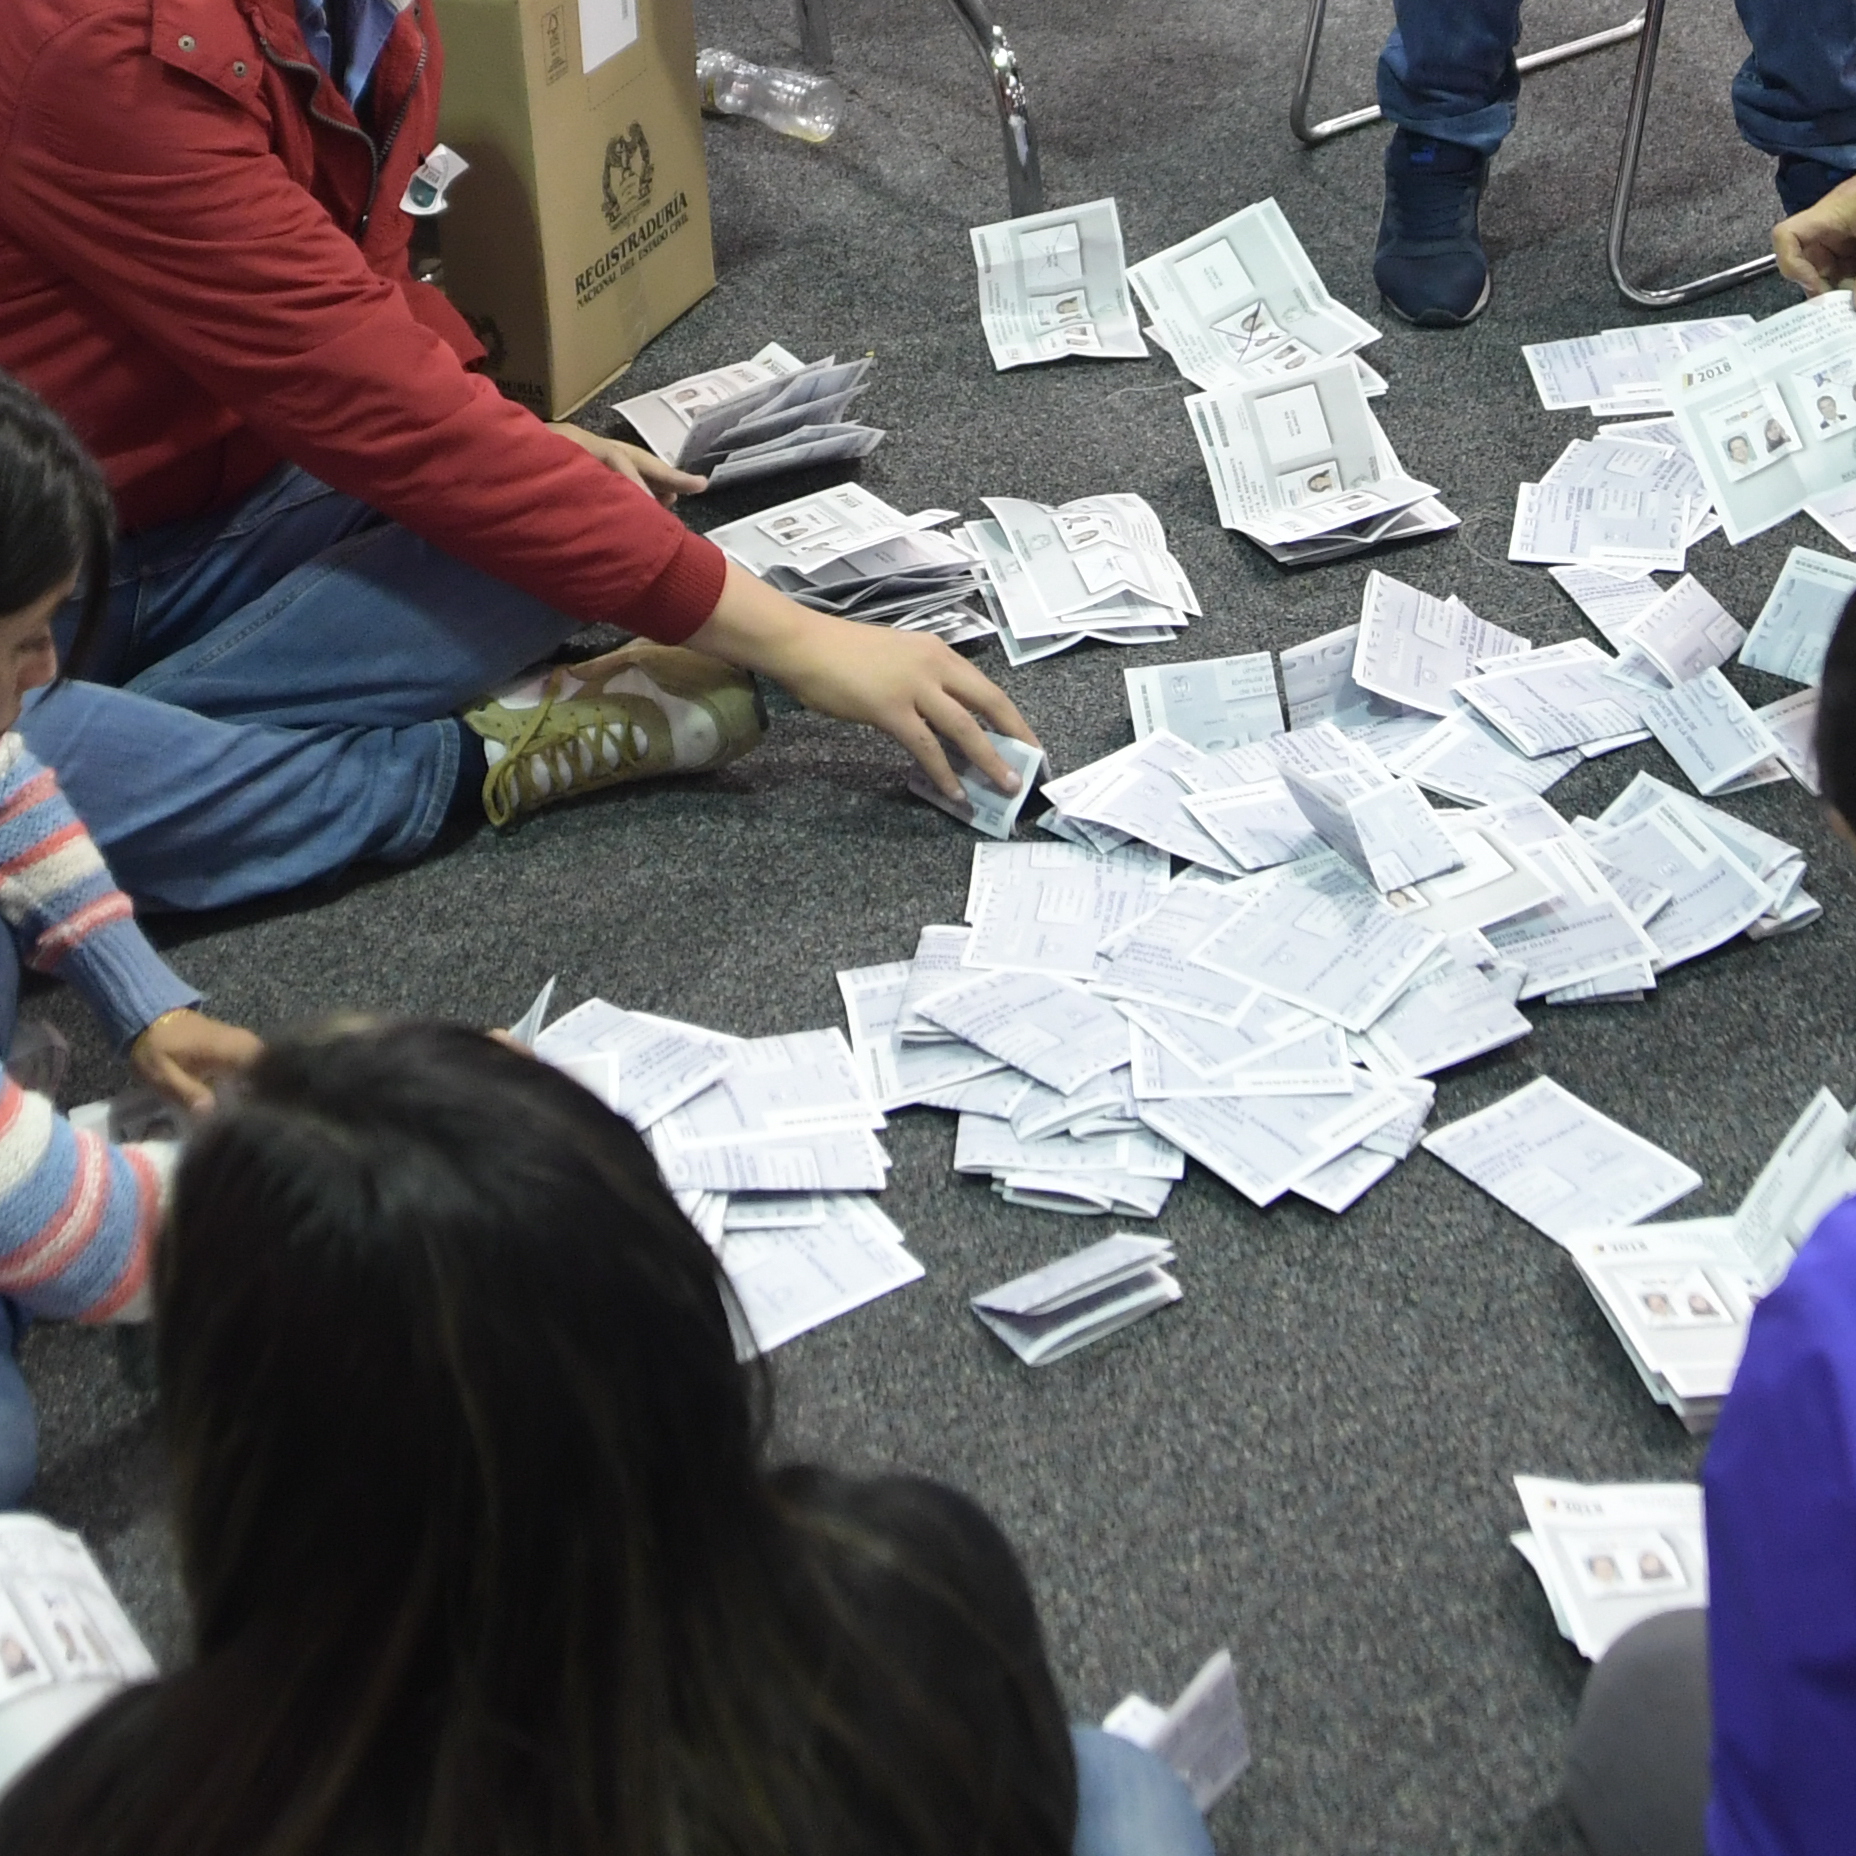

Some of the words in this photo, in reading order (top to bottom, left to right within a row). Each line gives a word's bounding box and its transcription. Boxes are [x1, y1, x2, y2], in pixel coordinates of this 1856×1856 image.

[574, 190, 688, 296] REGISTRADURÍA
[576, 271, 617, 311] NACIONAL
[620, 256, 636, 276] DEL
[638, 229, 669, 261] ESTADO
[670, 211, 689, 235] CIVIL
[1696, 361, 1732, 383] 2018
